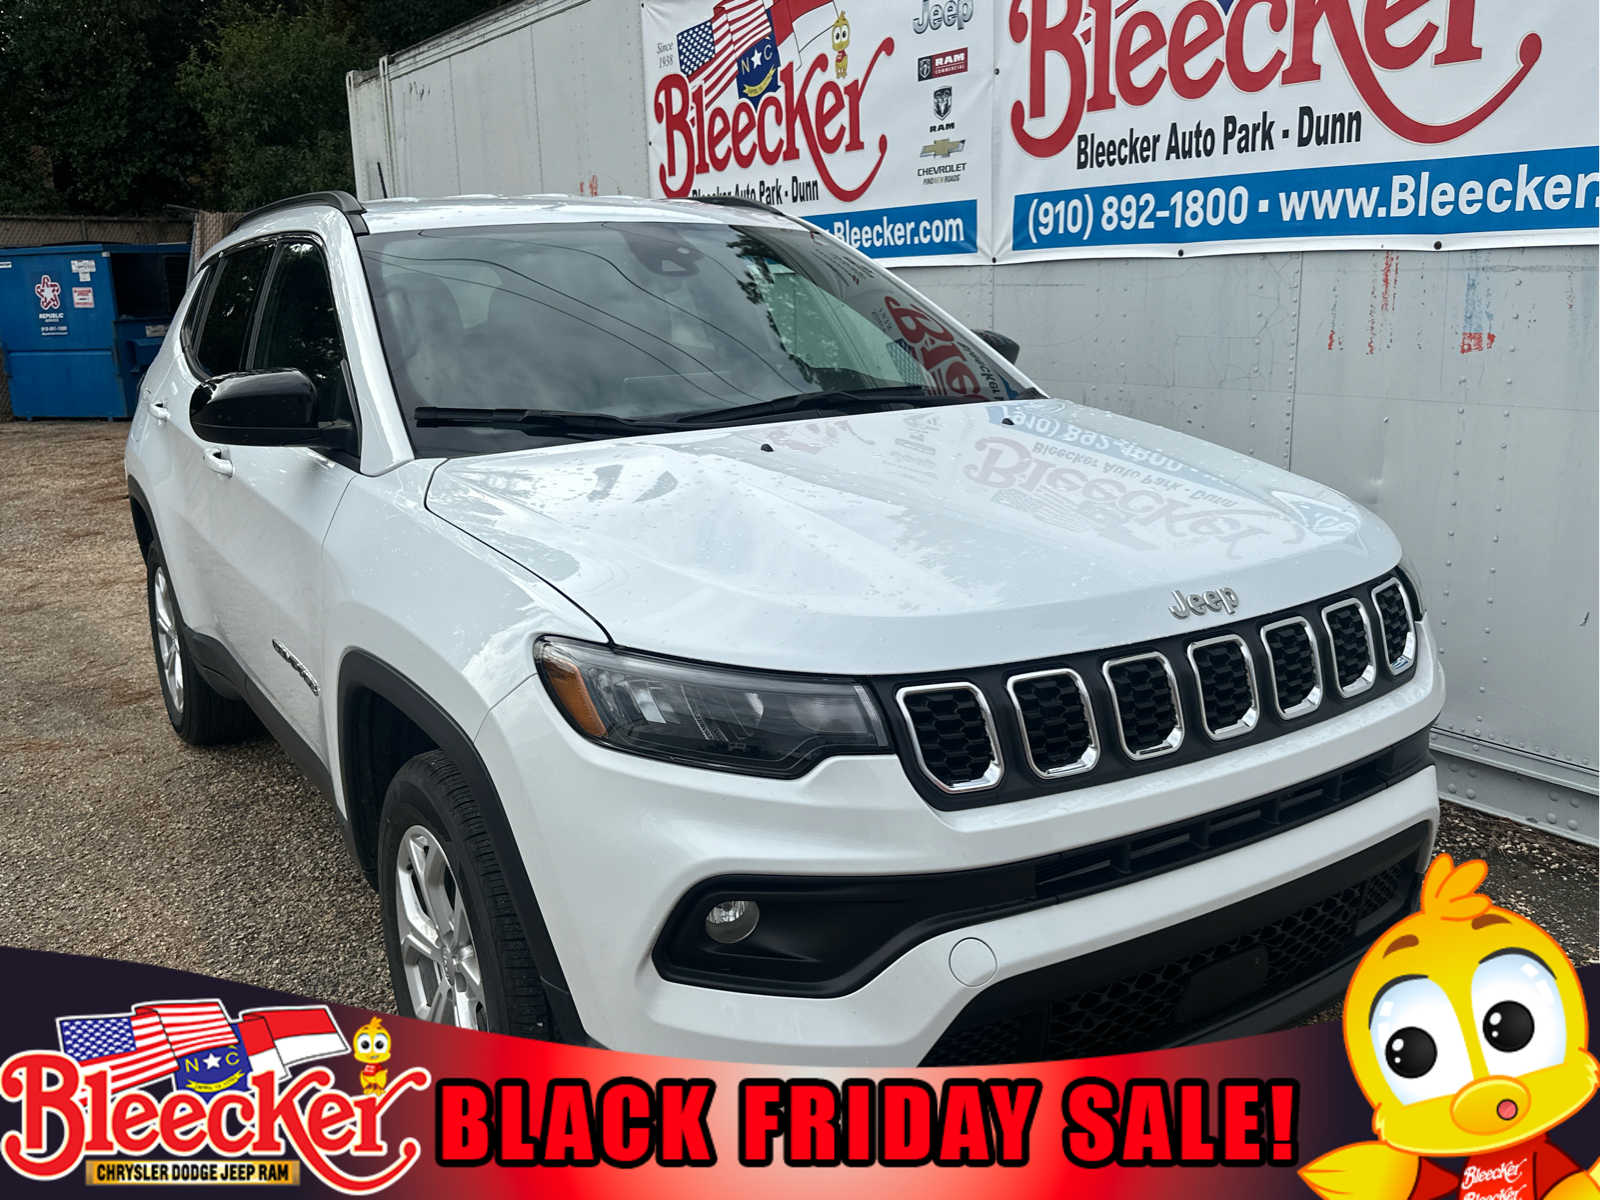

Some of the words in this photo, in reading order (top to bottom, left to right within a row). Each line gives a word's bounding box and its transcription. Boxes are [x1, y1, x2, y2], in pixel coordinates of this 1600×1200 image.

[912, 0, 974, 34] Jeep
[935, 53, 965, 66] RAM
[654, 37, 895, 202] Bleecker
[929, 122, 955, 132] RAM
[1076, 128, 1161, 170] Bleecker
[1165, 121, 1215, 160] Auto
[1223, 110, 1275, 155] Park
[1297, 106, 1362, 148] Dunn
[917, 163, 968, 176] CHEVROLET
[760, 178, 783, 205] Park
[792, 176, 819, 202] Dunn
[1028, 194, 1093, 243] (910)
[1101, 185, 1249, 233] 892-1800
[1168, 587, 1239, 620] Jeep
